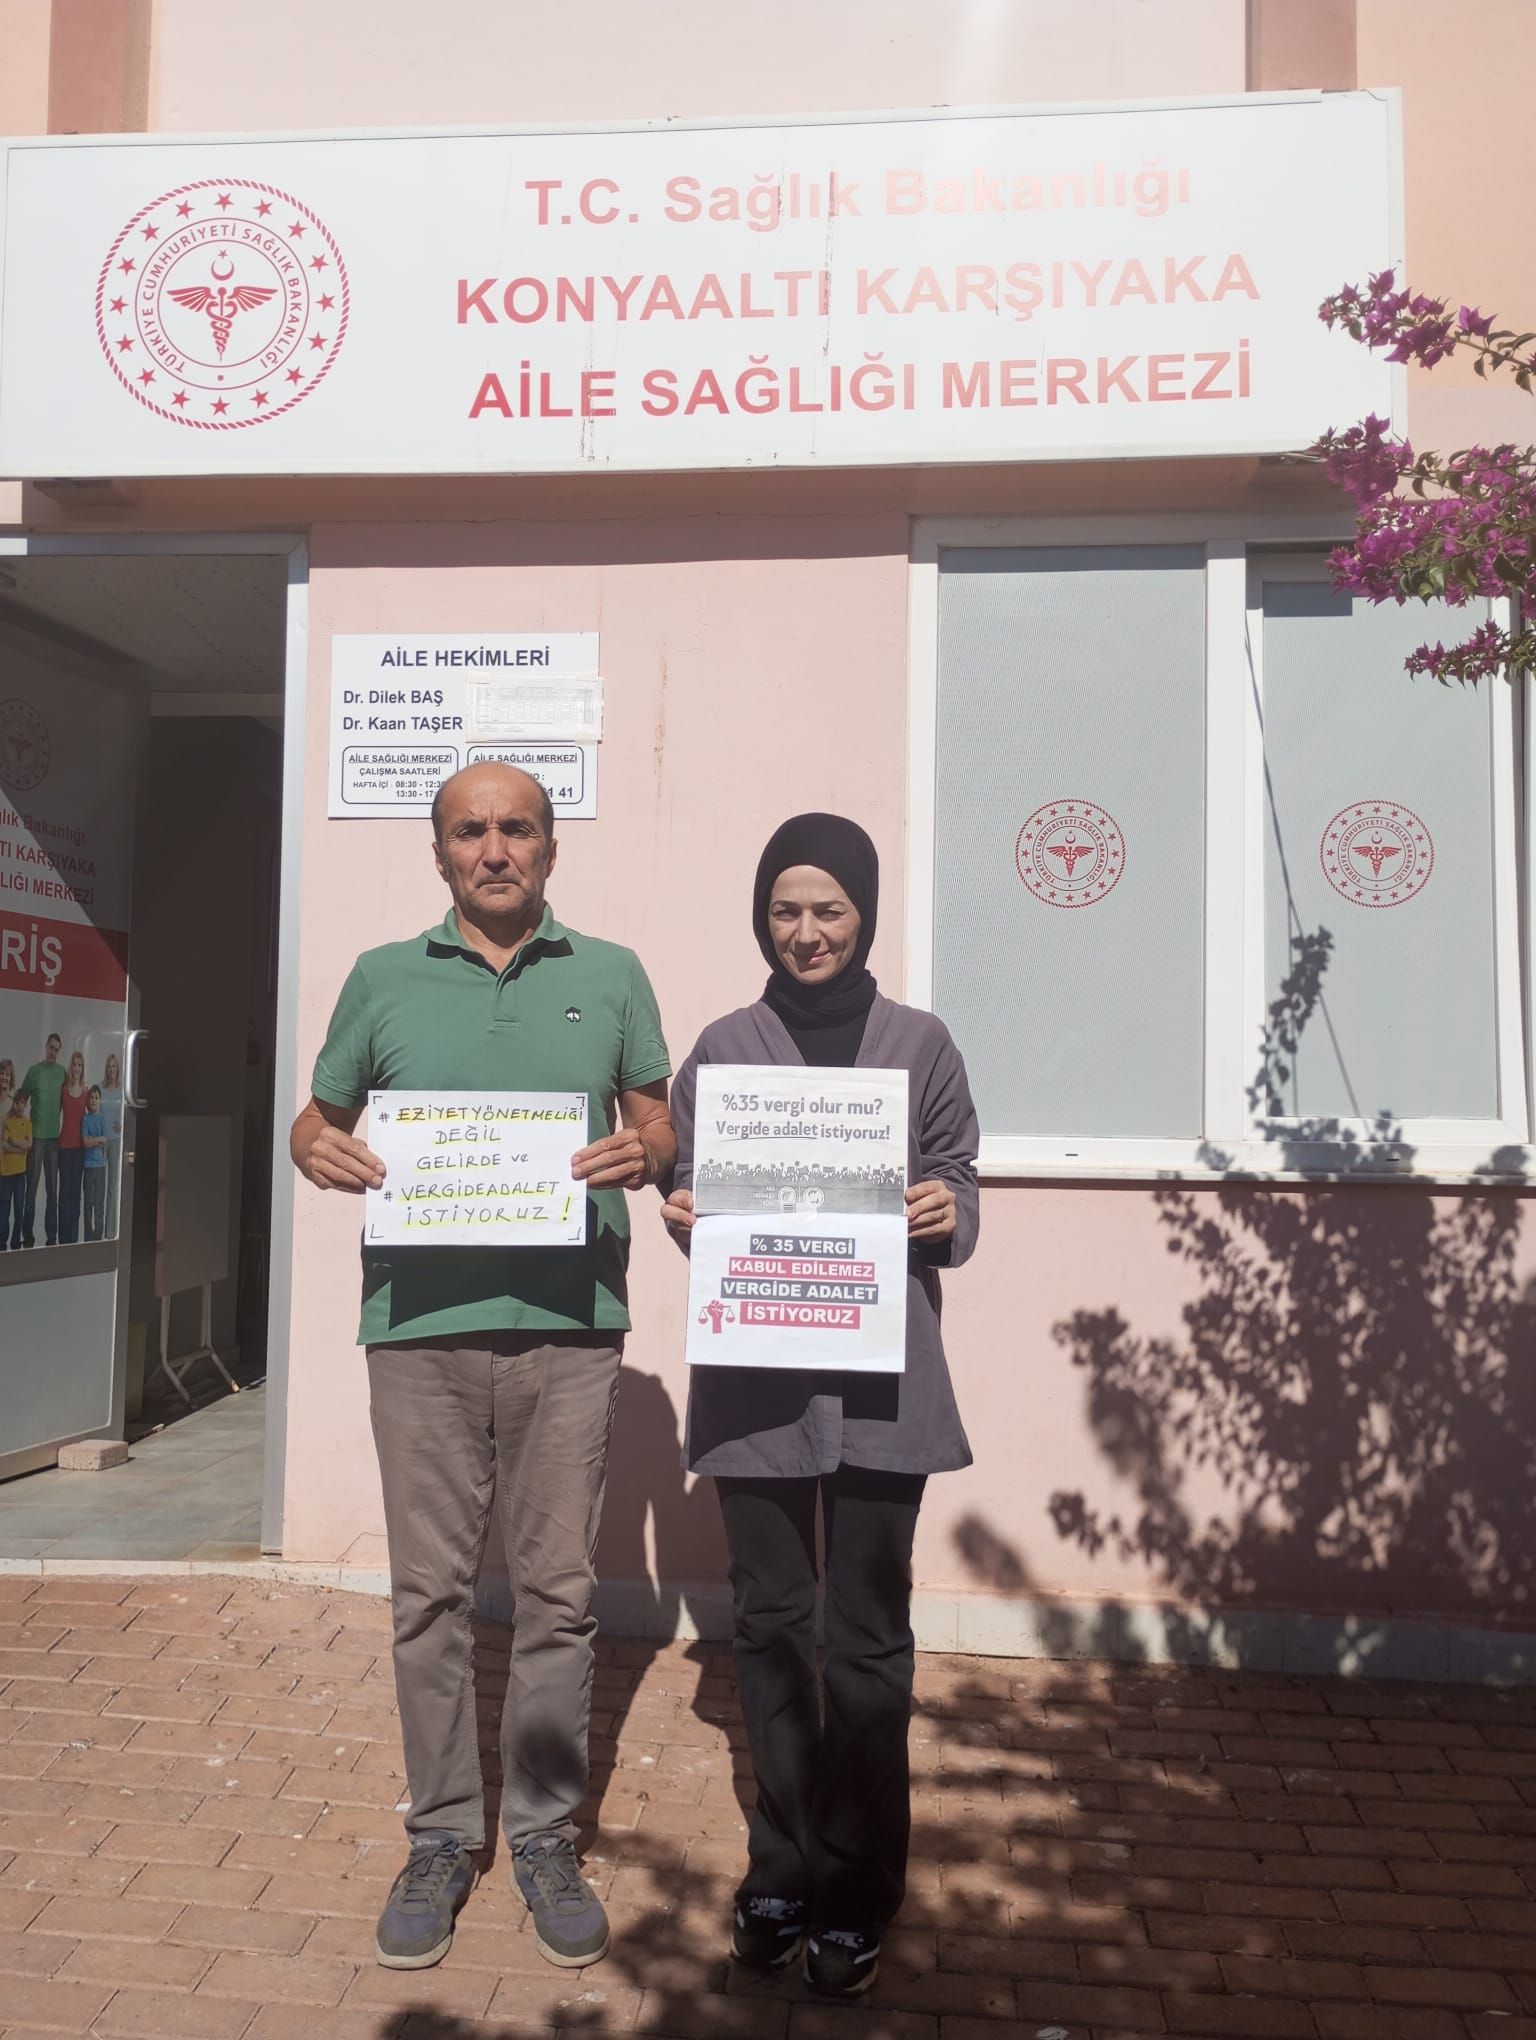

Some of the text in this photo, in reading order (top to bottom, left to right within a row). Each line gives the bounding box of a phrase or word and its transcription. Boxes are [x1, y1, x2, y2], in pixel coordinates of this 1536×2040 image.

[525, 156, 1191, 232] T.C. Sağlık Bakanlığı
[142, 222, 303, 373] TÜRKİYE CUMHURİYETİ SAĞLIK BAKANLIĞI
[456, 254, 1262, 324] KONYAALTI KARŞIYAKA
[467, 338, 1252, 419] AİLE SAĞLIĞI MERKEZİ
[380, 646, 550, 666] AİLE HEKİMLERİ
[343, 690, 443, 706] Dr. Dilek BAŞ
[343, 717, 463, 733] Dr. Kaan TAŞER
[349, 753, 452, 763] AİLE SAĞLIĞI MERKEZİ
[497, 753, 534, 763] SAĞLIĞI
[537, 753, 578, 763] MERKEZİ
[360, 766, 441, 776] ÇALIŞMA SAATLERİ
[379, 780, 389, 790] İÇİ
[396, 790, 417, 798] 13:30
[559, 787, 573, 798] 41
[16, 844, 97, 877] KARŞIYAKA
[33, 878, 95, 904] MERKEZİ
[722, 1094, 883, 1117] %35 vergi olur mu?
[435, 1125, 502, 1145] DEĞİL
[716, 1121, 891, 1142] Vergide adalet istiyoruz!
[416, 1152, 529, 1170] GELİRDE ve
[773, 1239, 794, 1252] 35
[799, 1236, 854, 1255] VERGİ
[730, 1260, 873, 1278] KABUL EDİLEMEZ
[722, 1280, 877, 1301] VERGİDE ADALET
[746, 1303, 855, 1325] İSTİYORUZ
